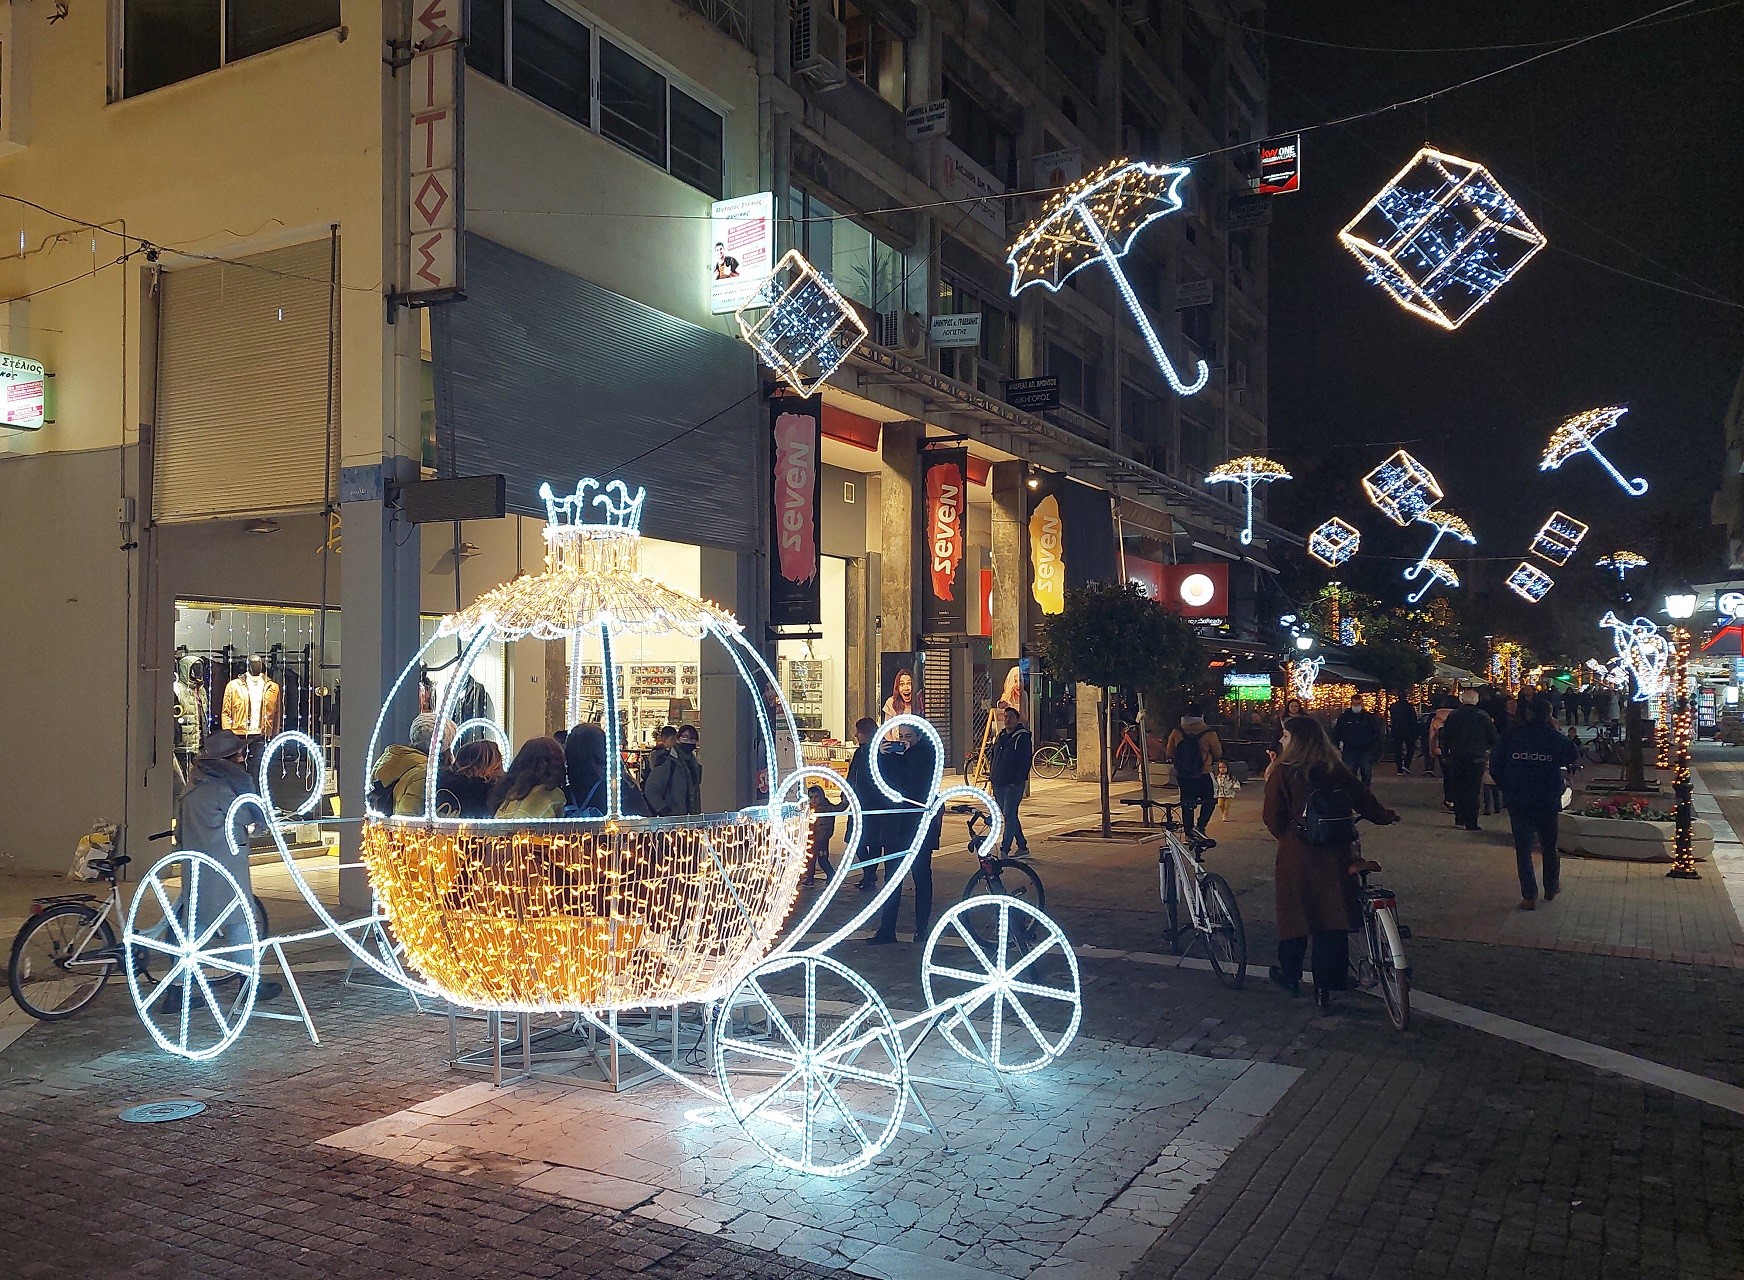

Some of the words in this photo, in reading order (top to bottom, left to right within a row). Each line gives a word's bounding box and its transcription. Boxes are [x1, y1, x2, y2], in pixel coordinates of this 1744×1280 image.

[1279, 145, 1295, 156] ONE
[942, 328, 967, 336] ΛΟΓΙΣΤΗΣ
[2, 357, 43, 375] Στέλιος
[1512, 751, 1553, 762] adidas
